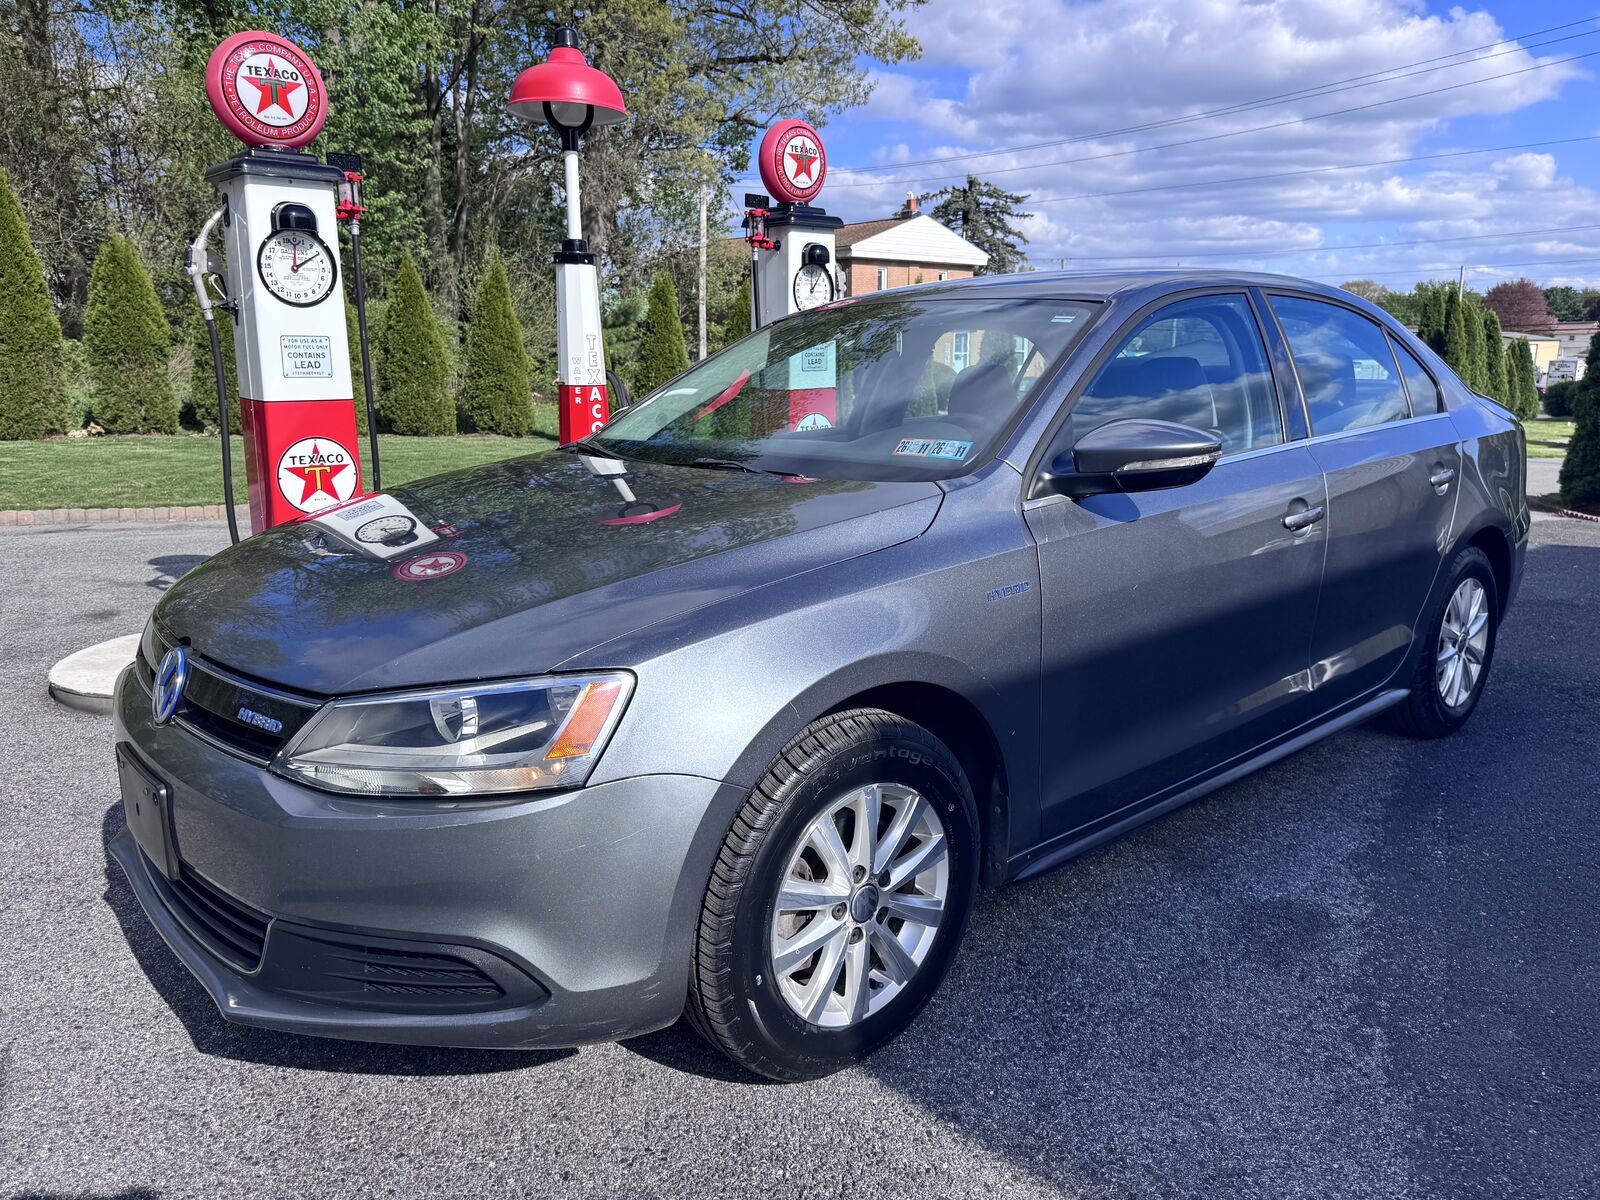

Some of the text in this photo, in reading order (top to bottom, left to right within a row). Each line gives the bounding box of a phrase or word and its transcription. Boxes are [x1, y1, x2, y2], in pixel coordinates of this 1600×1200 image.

[258, 43, 304, 68] COMPANY
[246, 65, 299, 80] TEXACO
[260, 78, 287, 104] T
[229, 94, 316, 136] PETROLEUM PRODUCTS
[790, 144, 817, 156] TEXACO
[294, 361, 321, 369] LEAD
[572, 356, 582, 404] WATER
[896, 441, 910, 453] 26
[918, 443, 930, 454] 11
[932, 442, 945, 454] 26
[955, 446, 967, 457] 11
[289, 454, 344, 466] TEXACO
[304, 466, 331, 491] T
[986, 581, 1030, 601] HYBRID
[237, 707, 282, 733] HYBRID
